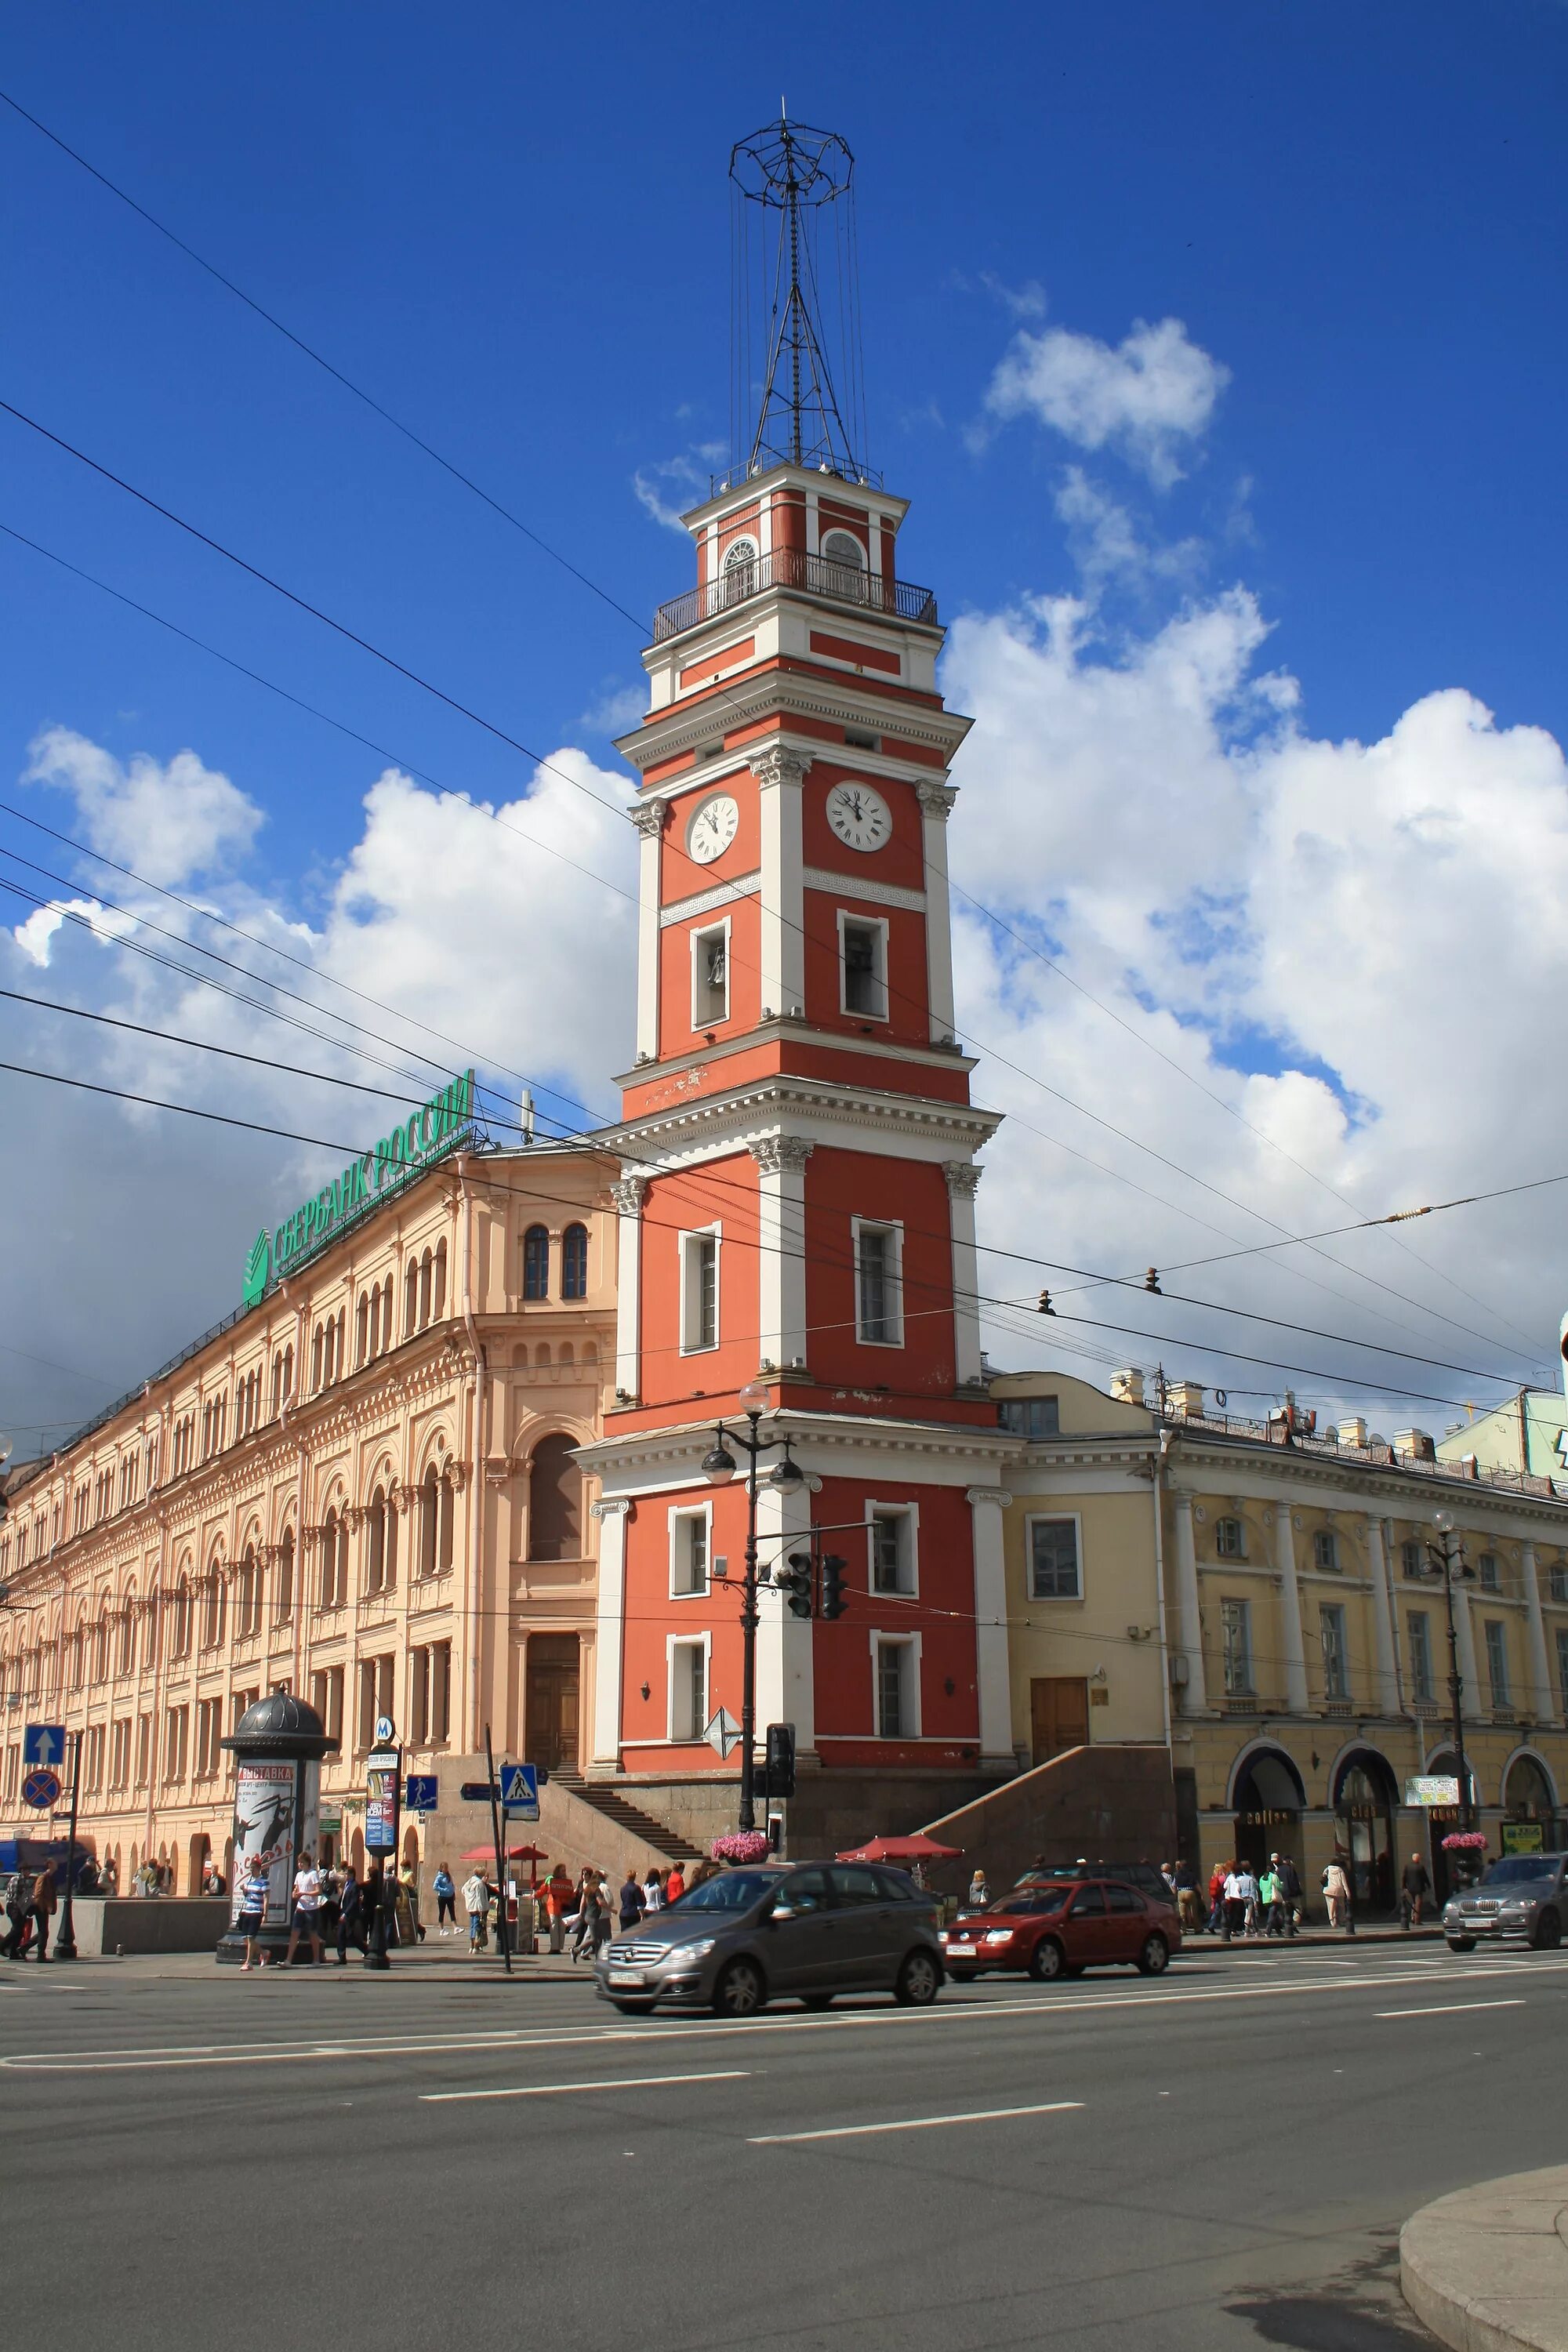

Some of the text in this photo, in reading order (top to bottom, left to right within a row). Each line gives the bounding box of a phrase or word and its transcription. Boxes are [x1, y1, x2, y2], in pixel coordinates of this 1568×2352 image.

[272, 1068, 474, 1269] СБЕРБАНК РОССИИ
[242, 1767, 291, 1779] ВЫСТАВКА
